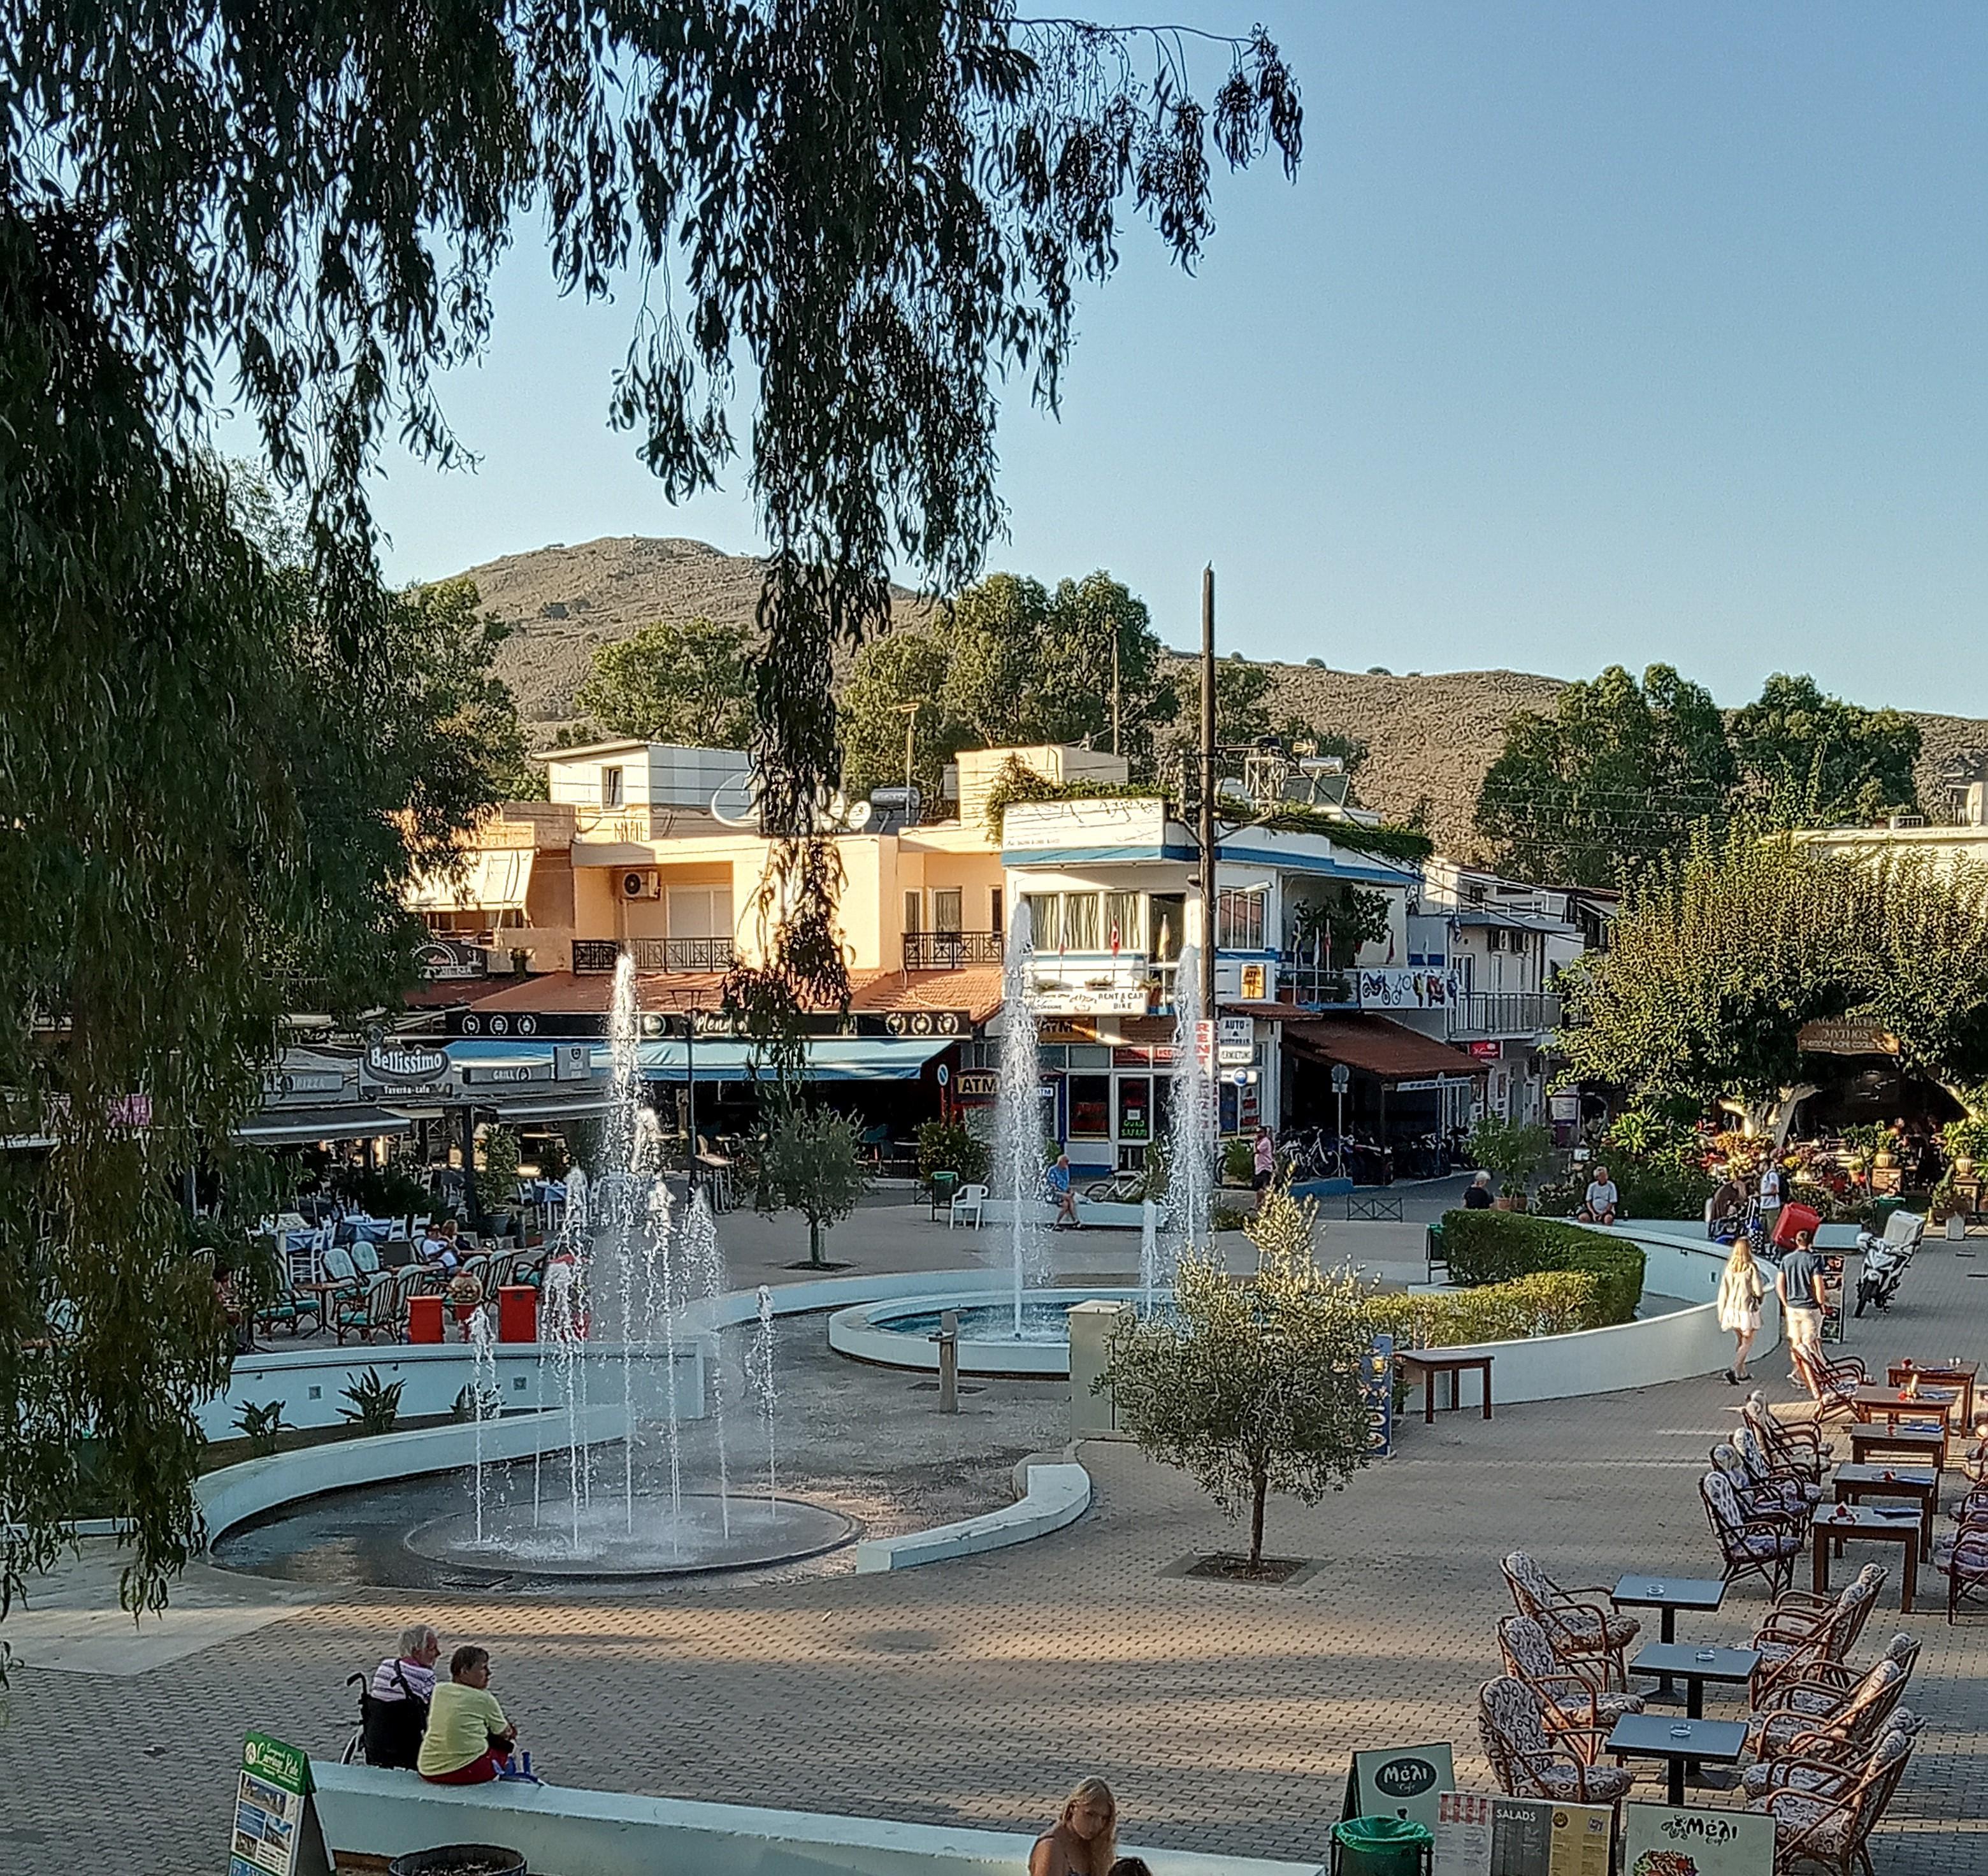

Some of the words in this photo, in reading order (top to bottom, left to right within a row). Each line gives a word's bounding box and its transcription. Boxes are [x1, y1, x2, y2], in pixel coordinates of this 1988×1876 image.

[370, 1046, 443, 1074] Bellissimo
[493, 1069, 515, 1080] GRILL
[962, 1078, 998, 1093] ATM
[1497, 1808, 1536, 1822] SALADS
